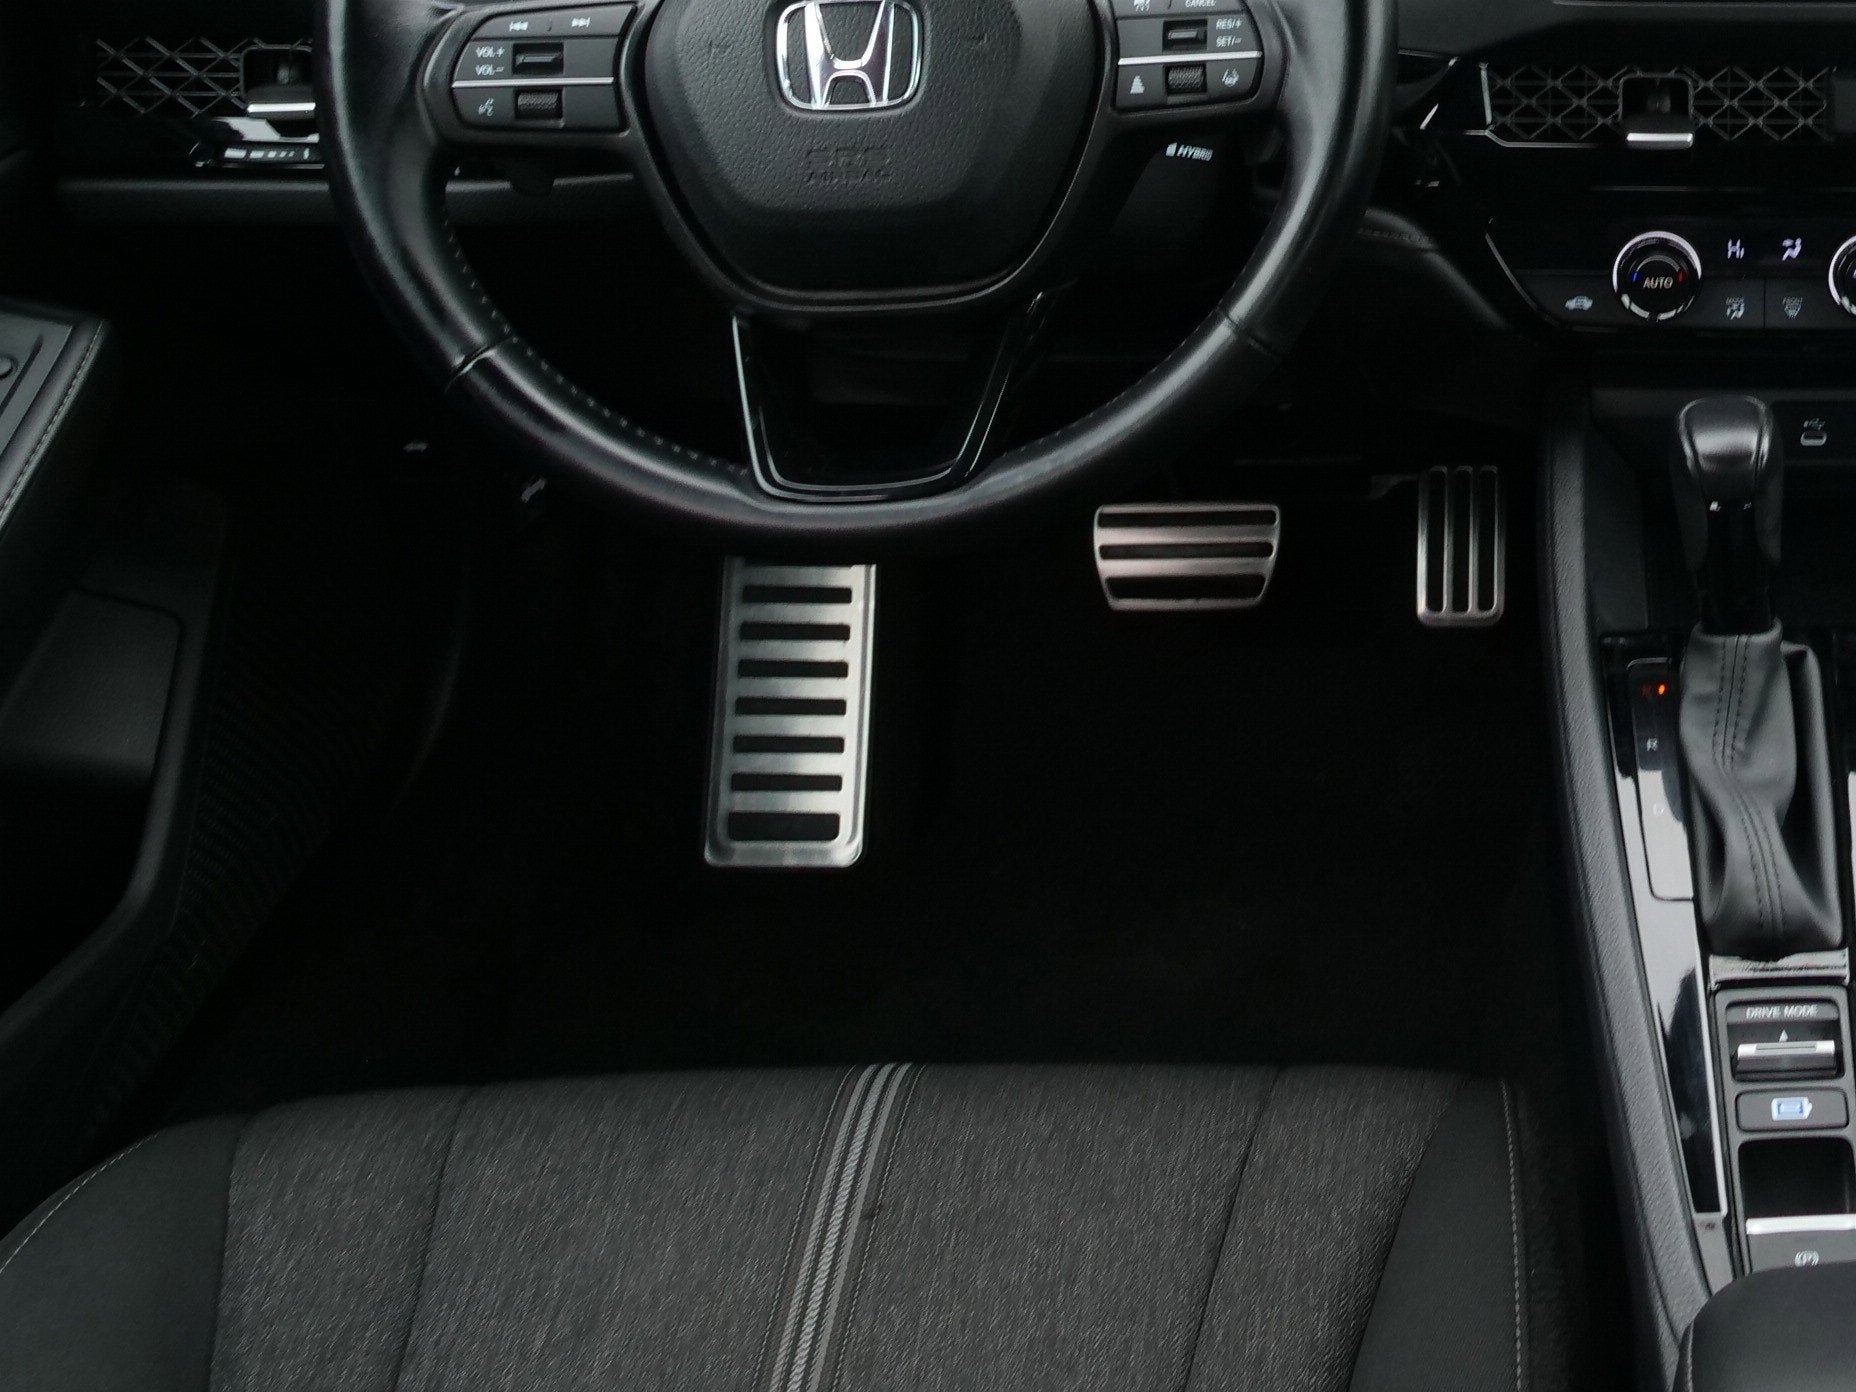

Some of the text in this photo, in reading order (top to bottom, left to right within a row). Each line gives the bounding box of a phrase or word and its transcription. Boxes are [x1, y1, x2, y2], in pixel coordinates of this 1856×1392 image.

[1176, 144, 1214, 162] HYBRID
[1642, 276, 1674, 289] AUTO
[1646, 737, 1659, 752] R
[1745, 1004, 1819, 1019] DRIVE MODE
